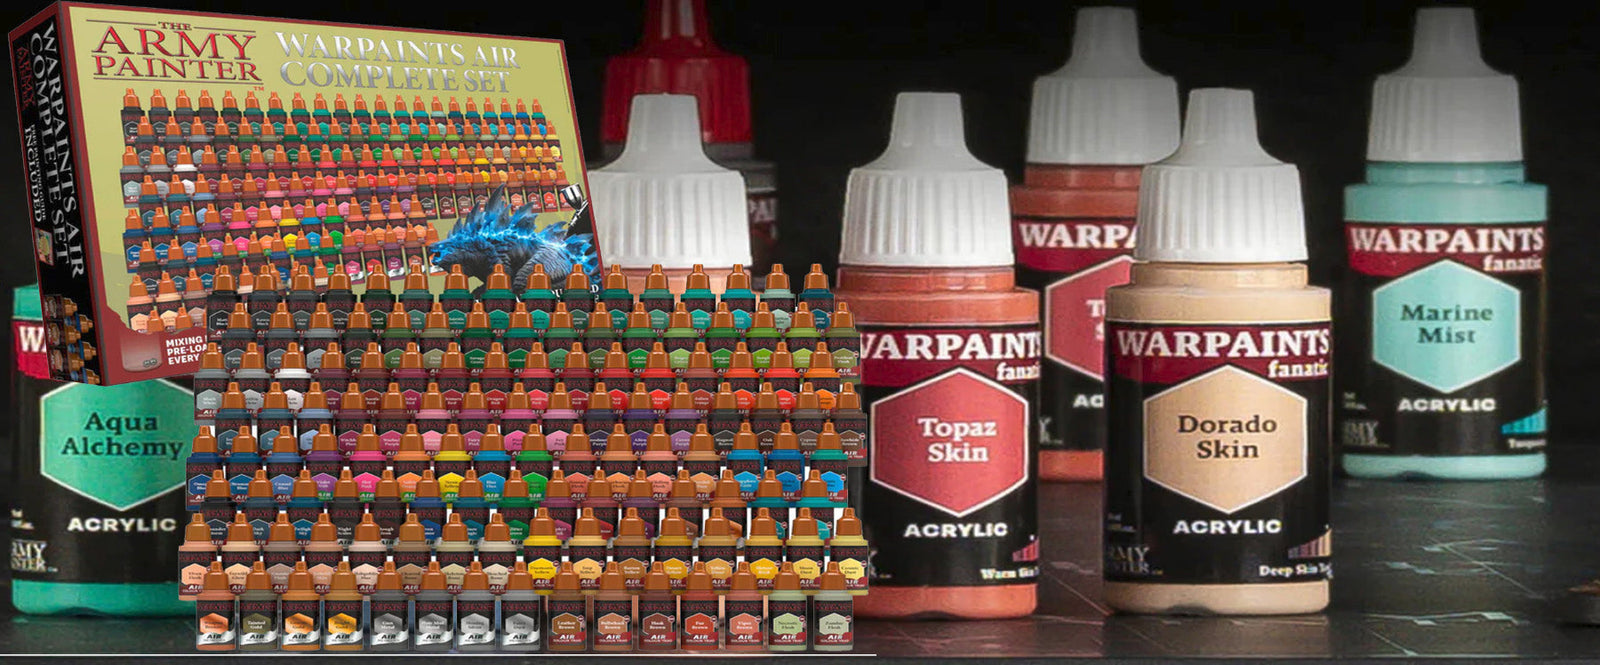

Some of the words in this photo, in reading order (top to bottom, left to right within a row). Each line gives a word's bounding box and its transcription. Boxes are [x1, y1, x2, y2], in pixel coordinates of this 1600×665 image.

[158, 22, 192, 30] THE
[91, 26, 256, 60] ARMY
[275, 32, 466, 66] WARPAINTS
[473, 45, 520, 68] AIR
[92, 55, 262, 81] PAINTER
[280, 61, 460, 91] COMPLETE
[463, 69, 510, 93] SET
[30, 32, 61, 203] COMPLETE
[52, 210, 70, 264] SET
[42, 22, 77, 212] WARPAINTS
[66, 221, 84, 279] AIR
[24, 126, 41, 222] INCLUDED
[1349, 226, 1545, 253] WARPAINTS
[1482, 255, 1544, 272] fanatic
[1400, 304, 1494, 322] Marine
[166, 336, 203, 348] MIXING
[1116, 329, 1330, 358] WARPAINTS
[1417, 326, 1476, 344] Mist
[167, 344, 207, 356] PRE-LOA
[168, 353, 200, 365] EVERY
[1268, 358, 1328, 378] fanatic
[1398, 398, 1497, 412] ACRYLIC
[84, 412, 158, 435] Aqua
[917, 417, 998, 442] Topaz
[1178, 415, 1278, 434] Dorado
[62, 436, 184, 460] Alchemy
[927, 442, 989, 463] Skin
[1196, 440, 1260, 459] Skin
[66, 517, 177, 532] ACRYLIC
[904, 523, 1008, 538] ACRYLIC
[1172, 520, 1282, 534] ACRYLIC
[1259, 564, 1294, 578] Deep
